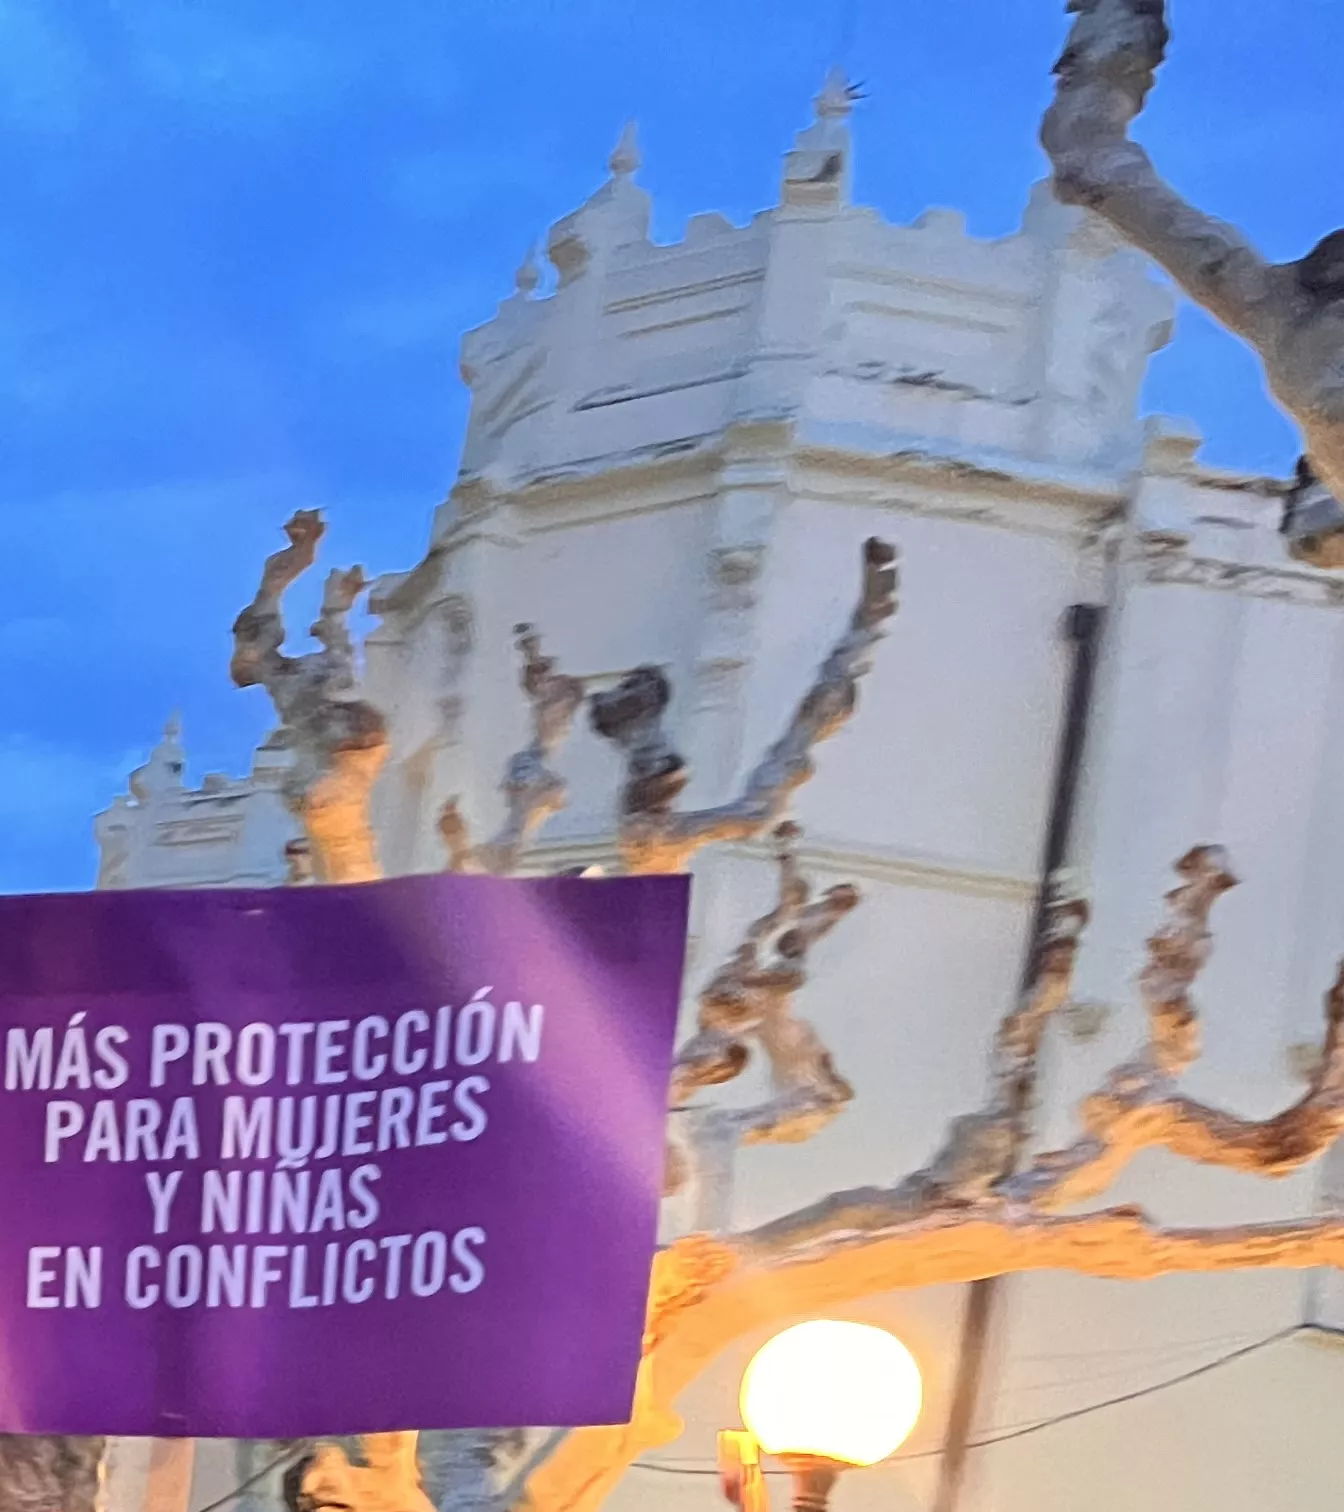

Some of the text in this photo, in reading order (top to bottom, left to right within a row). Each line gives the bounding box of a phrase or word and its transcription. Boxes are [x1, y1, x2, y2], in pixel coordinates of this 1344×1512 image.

[5, 986, 544, 1091] MÁS PROTECCIÓN
[43, 1076, 491, 1163] PARA MUJERES
[145, 1156, 382, 1235] Y NIÑAS
[25, 1227, 487, 1309] EN CONFLICTOS
